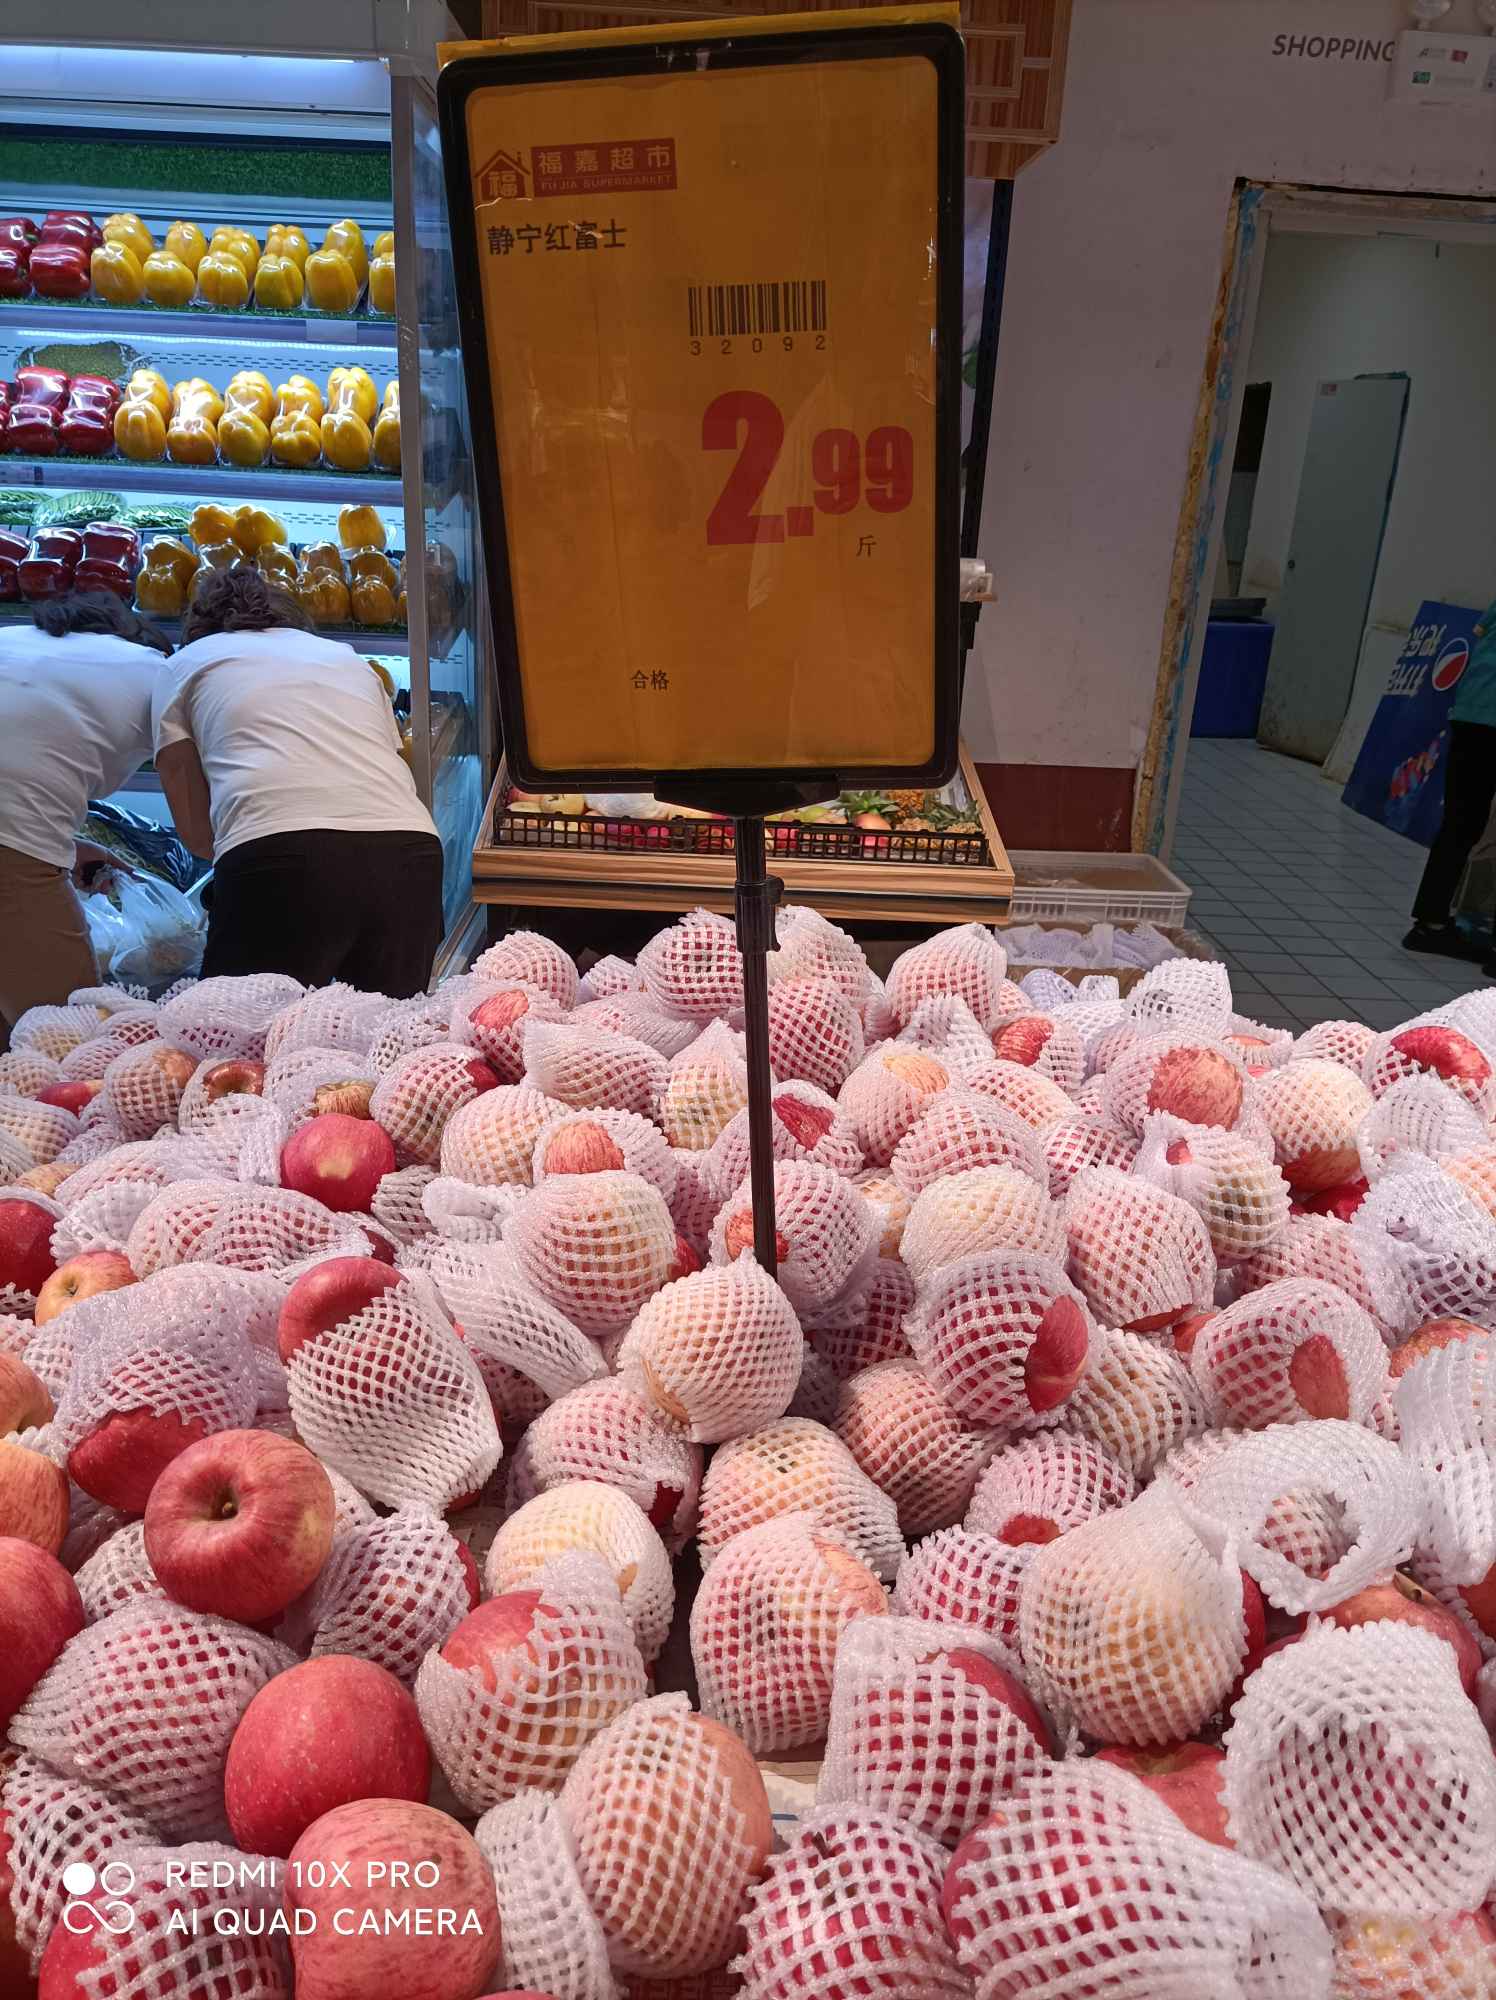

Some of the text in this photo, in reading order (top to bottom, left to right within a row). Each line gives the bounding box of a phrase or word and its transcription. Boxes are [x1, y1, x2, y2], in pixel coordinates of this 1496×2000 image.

[489, 144, 672, 198] 福 福嘉超市
[583, 174, 673, 190] SUPERMARKET
[487, 219, 627, 255] 静宁红富士
[702, 389, 914, 546] 2.99
[856, 534, 878, 557] 斤
[631, 670, 670, 690] 合格
